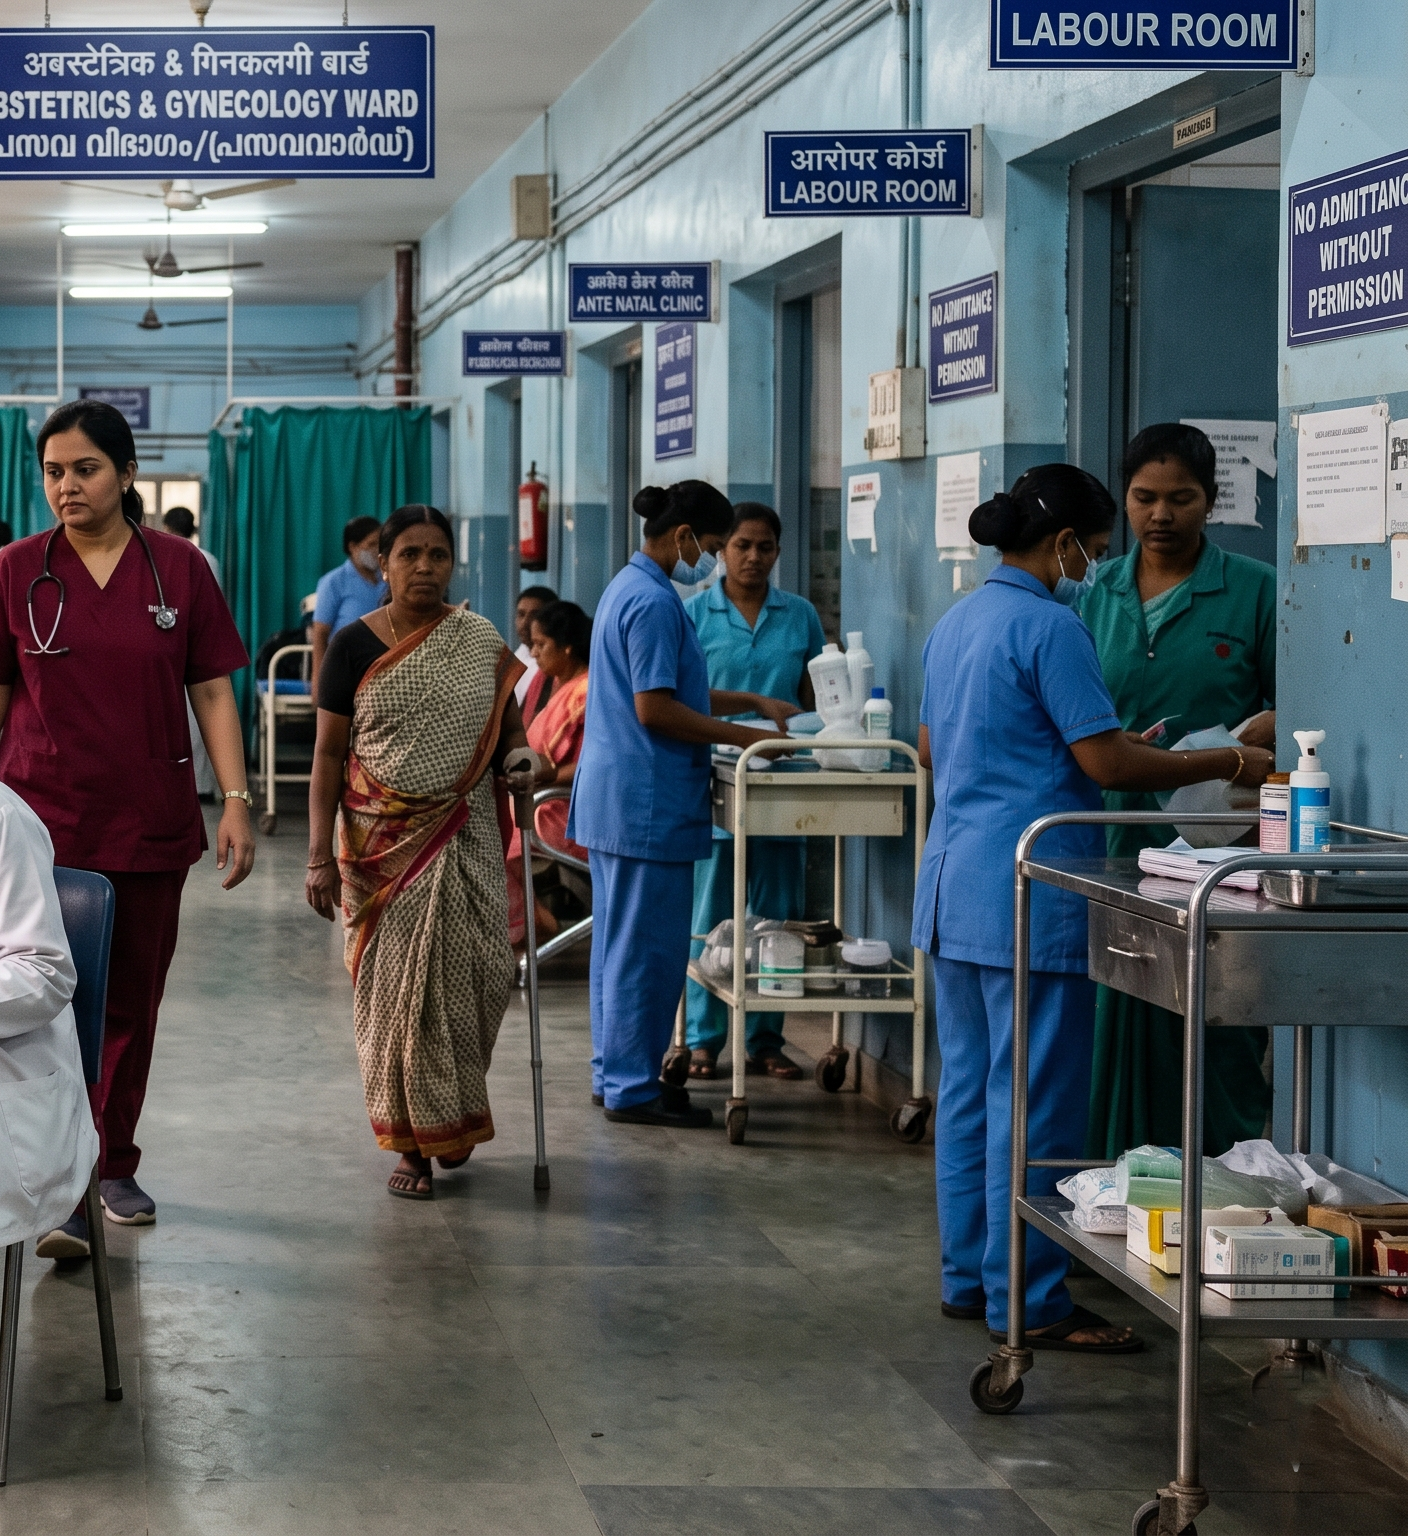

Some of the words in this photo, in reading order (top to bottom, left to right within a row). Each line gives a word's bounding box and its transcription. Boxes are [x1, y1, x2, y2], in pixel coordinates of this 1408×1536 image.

[1012, 12, 1160, 47] LABOUR
[1171, 12, 1277, 47] ROOM
[163, 49, 184, 77] &
[138, 90, 158, 119] &
[165, 89, 339, 119] GYNECOLOGY
[343, 89, 419, 118] WARD
[780, 179, 879, 204] LABOUR
[885, 179, 957, 203] ROOM
[1294, 201, 1316, 236] NO
[1319, 224, 1393, 272] WITHOUT
[576, 296, 613, 312] ANTE
[615, 295, 658, 312] NATAL
[659, 294, 704, 312] CLINIC
[1308, 268, 1404, 320] PERMISSION
[931, 304, 943, 328] NO
[943, 324, 979, 355] WITHOUT
